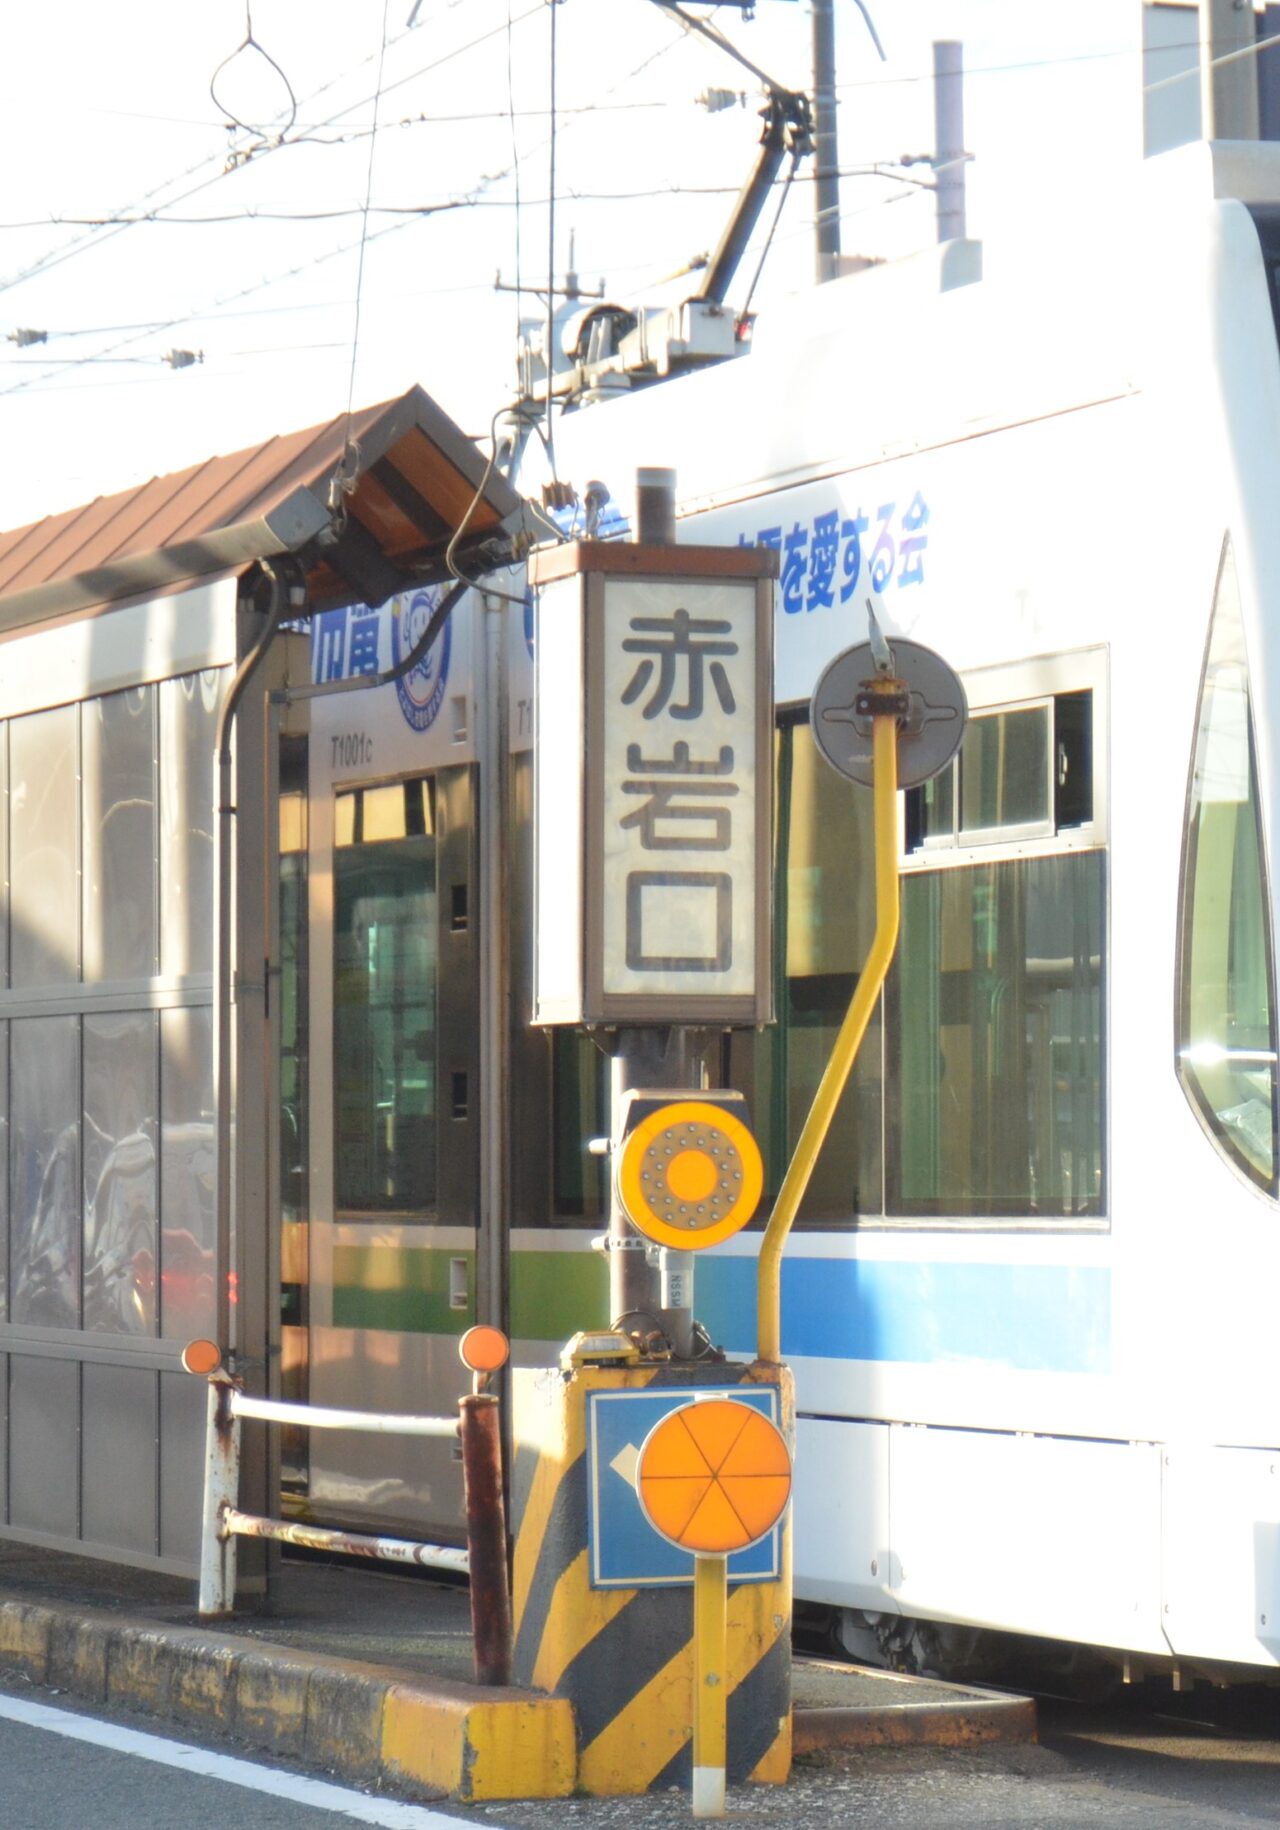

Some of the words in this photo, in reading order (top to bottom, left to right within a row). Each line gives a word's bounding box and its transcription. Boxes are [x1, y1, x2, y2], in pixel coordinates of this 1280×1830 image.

[738, 490, 930, 614] を愛する会
[620, 608, 739, 972] 赤岩口
